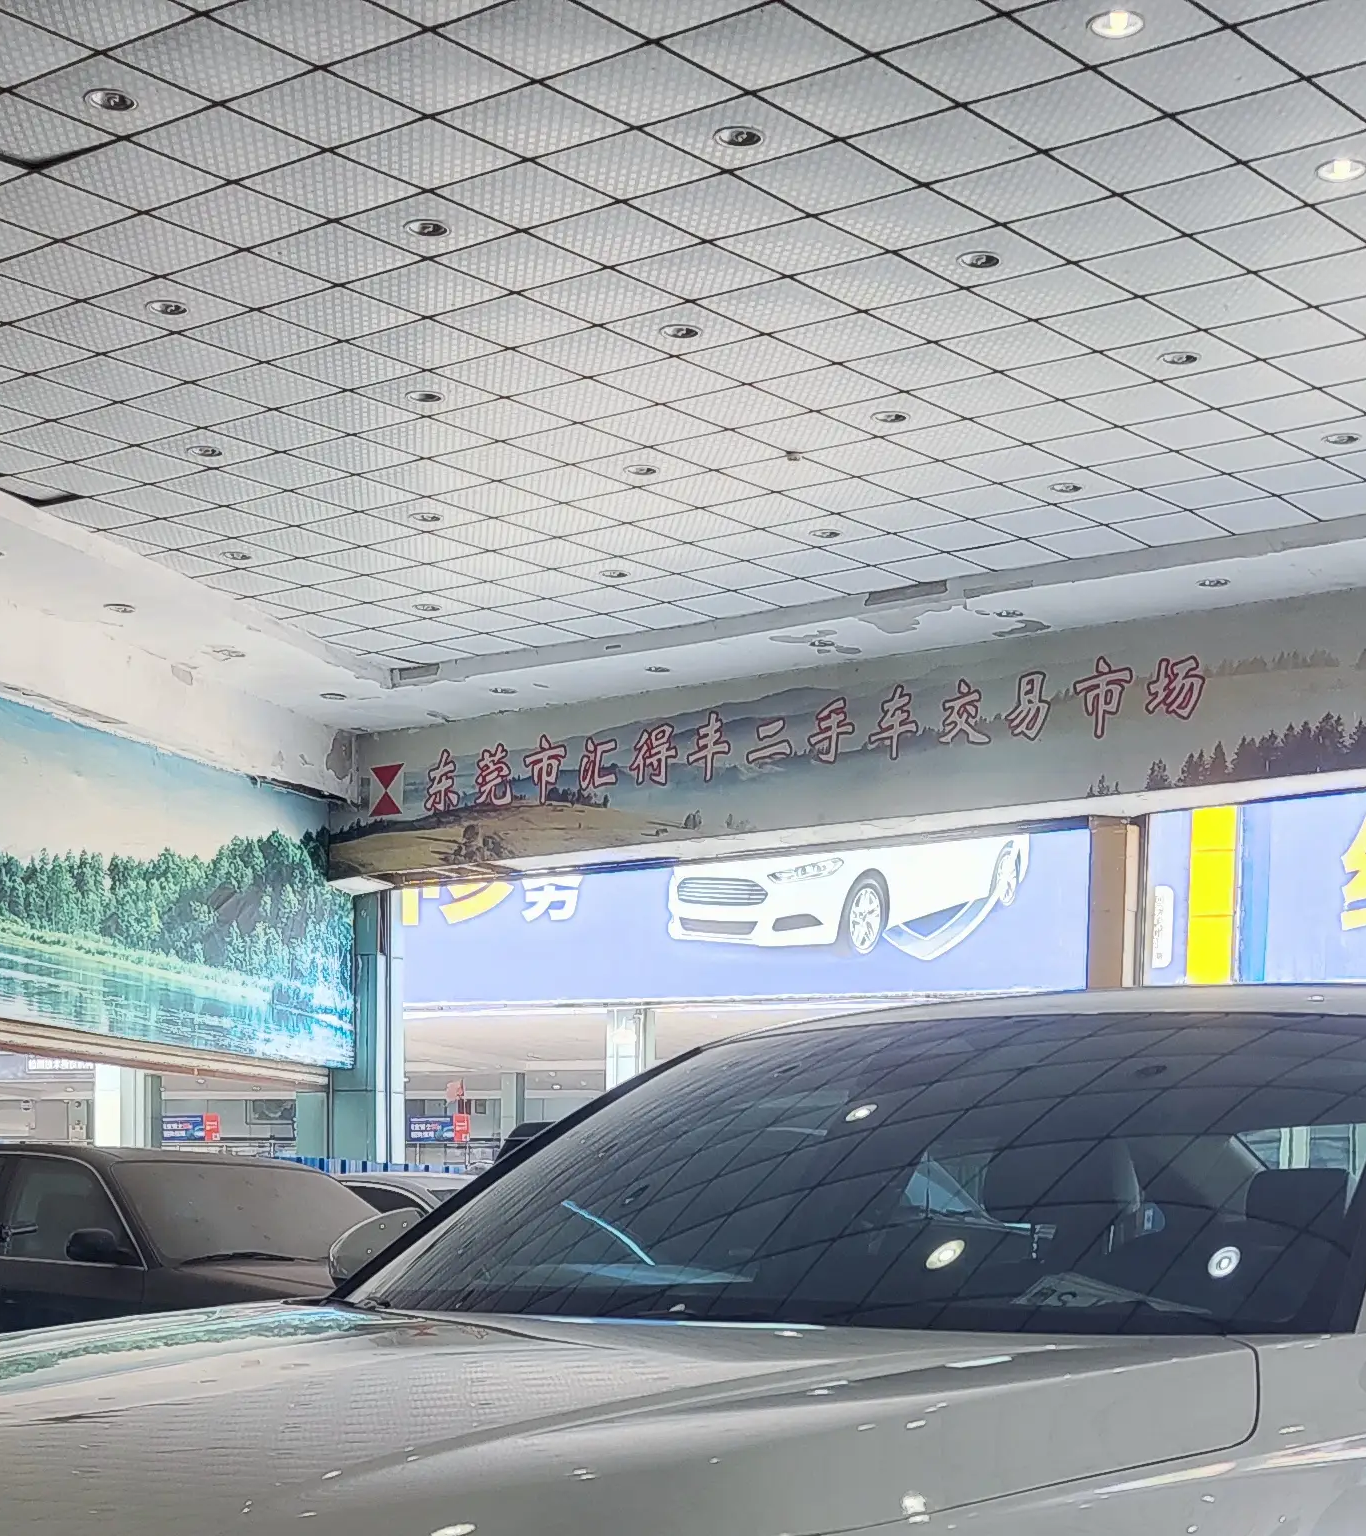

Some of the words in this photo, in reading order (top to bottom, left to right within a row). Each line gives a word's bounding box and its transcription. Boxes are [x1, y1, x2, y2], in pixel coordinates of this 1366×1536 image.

[423, 655, 1206, 812] 东莞市汇得丰二手车交易市场
